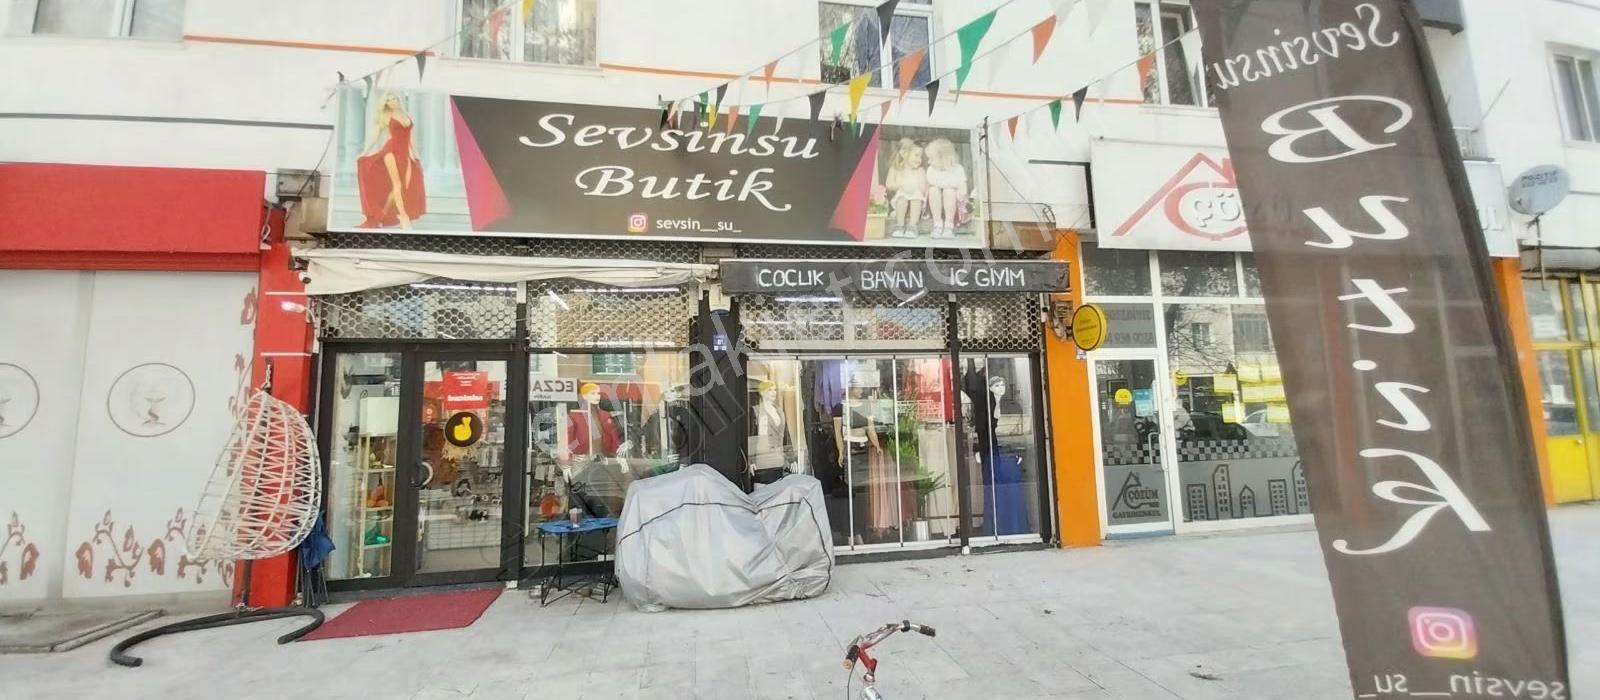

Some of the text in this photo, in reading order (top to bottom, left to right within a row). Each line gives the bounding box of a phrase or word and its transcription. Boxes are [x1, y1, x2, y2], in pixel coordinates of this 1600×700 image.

[518, 113, 820, 159] Sevsinsu
[575, 165, 792, 211] Butik
[860, 270, 924, 290] BAYAN
